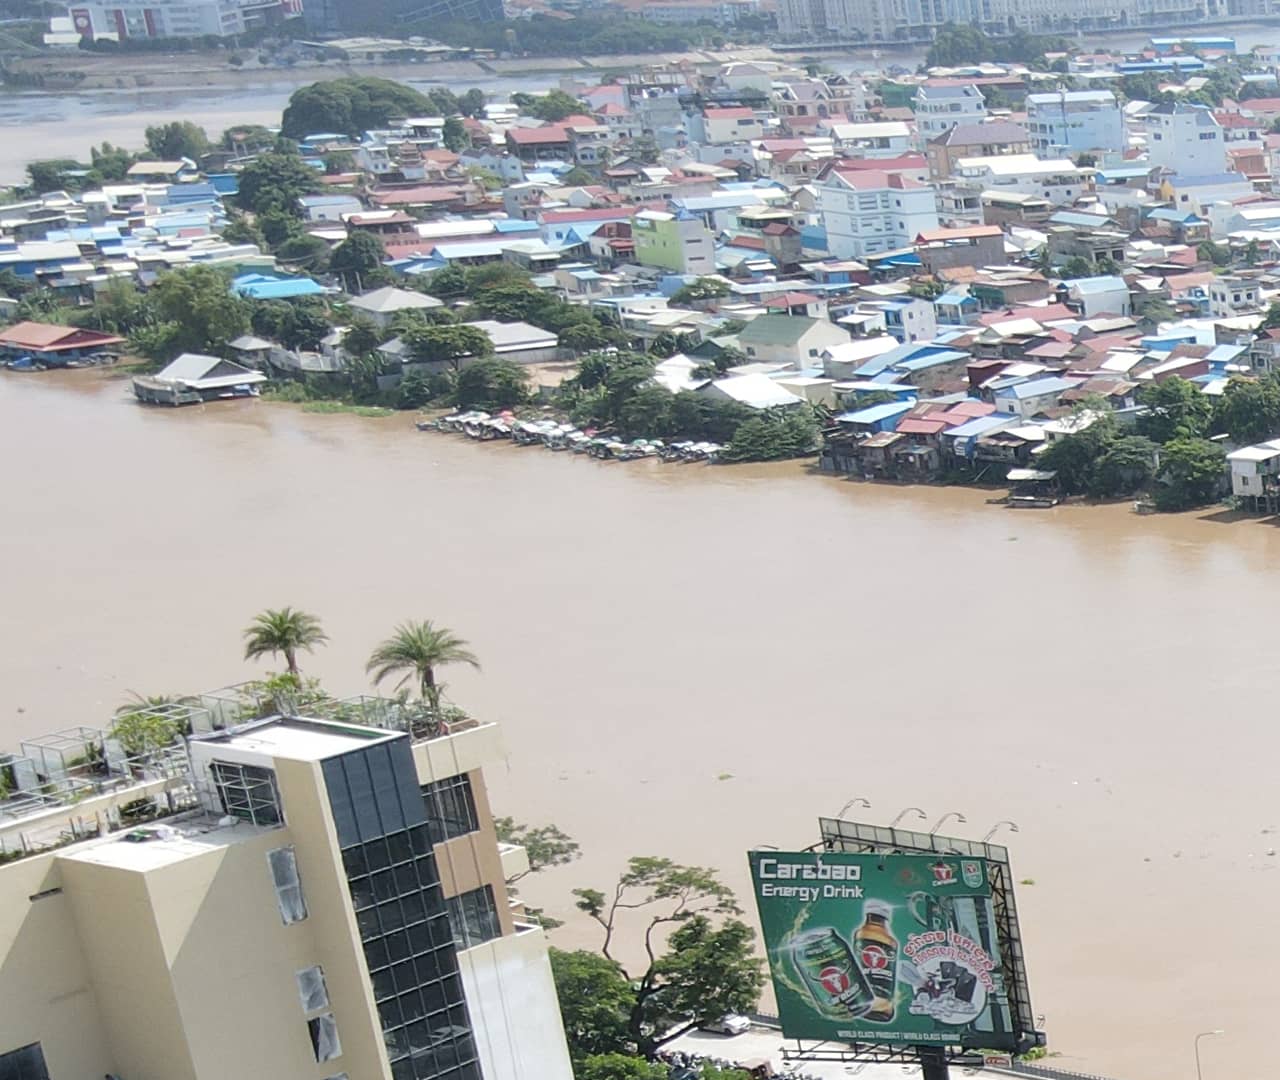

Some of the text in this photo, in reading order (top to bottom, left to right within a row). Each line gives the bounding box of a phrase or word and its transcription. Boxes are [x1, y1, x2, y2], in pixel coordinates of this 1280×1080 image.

[760, 858, 861, 881] Carabao
[762, 883, 864, 902] Energy Drink
